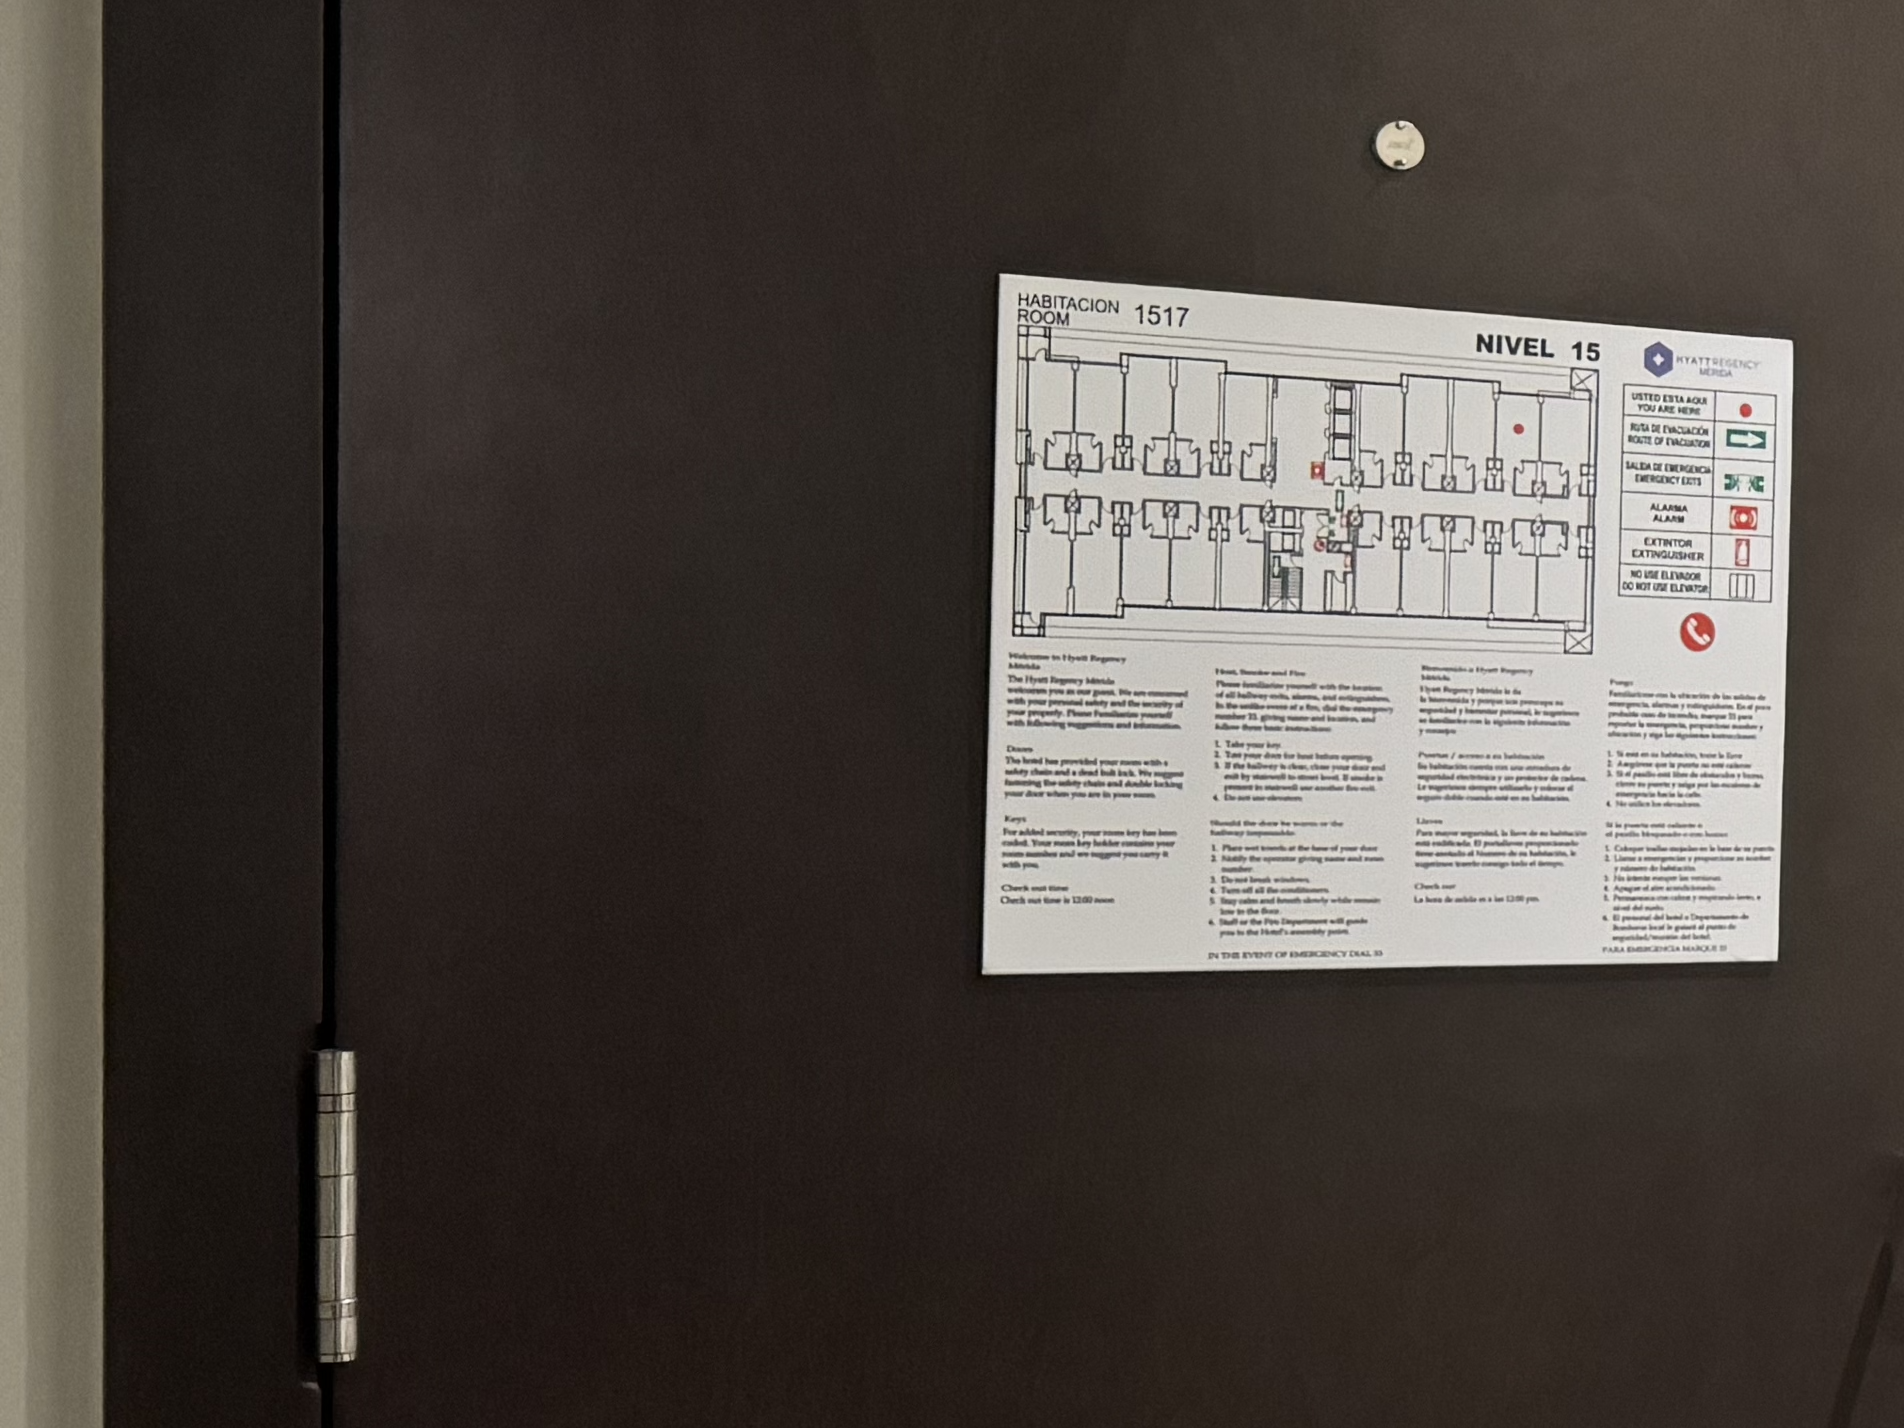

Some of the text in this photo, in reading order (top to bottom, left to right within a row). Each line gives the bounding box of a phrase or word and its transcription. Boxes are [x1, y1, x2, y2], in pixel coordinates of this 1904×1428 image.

[1018, 293, 1119, 313] HABITACION
[1018, 309, 1070, 325] ROOM
[1135, 304, 1189, 327] 1517
[1476, 333, 1600, 361] NIVEL 15
[1631, 392, 1660, 402] USTED
[1663, 394, 1684, 403] ESTA
[1638, 404, 1701, 415] YOU ARE HERE
[1651, 424, 1660, 433] DE
[1628, 435, 1652, 445] ROUTE
[1654, 437, 1664, 445] OF
[1626, 461, 1651, 470] SALIDA
[1653, 463, 1662, 471] DE
[1635, 473, 1681, 484] EMERGENCY
[1650, 503, 1688, 512] ALARMA
[1653, 514, 1684, 523] ALARM
[1644, 537, 1692, 548] EXTINTOR
[1632, 549, 1704, 561] EXTINGUISHER
[1631, 570, 1642, 578] NO
[1644, 570, 1659, 579] USE
[1622, 581, 1634, 590] DO
[1636, 582, 1651, 591] NOT
[1653, 583, 1667, 592] USE
[1008, 675, 1023, 683] The
[1049, 689, 1064, 697] you
[1007, 697, 1025, 706] with
[1027, 700, 1047, 708] your
[1007, 710, 1026, 718] your
[1005, 757, 1021, 765] The
[1003, 828, 1017, 836] For
[1082, 830, 1101, 838] your
[1032, 839, 1052, 847] Your
[1156, 841, 1175, 849] your
